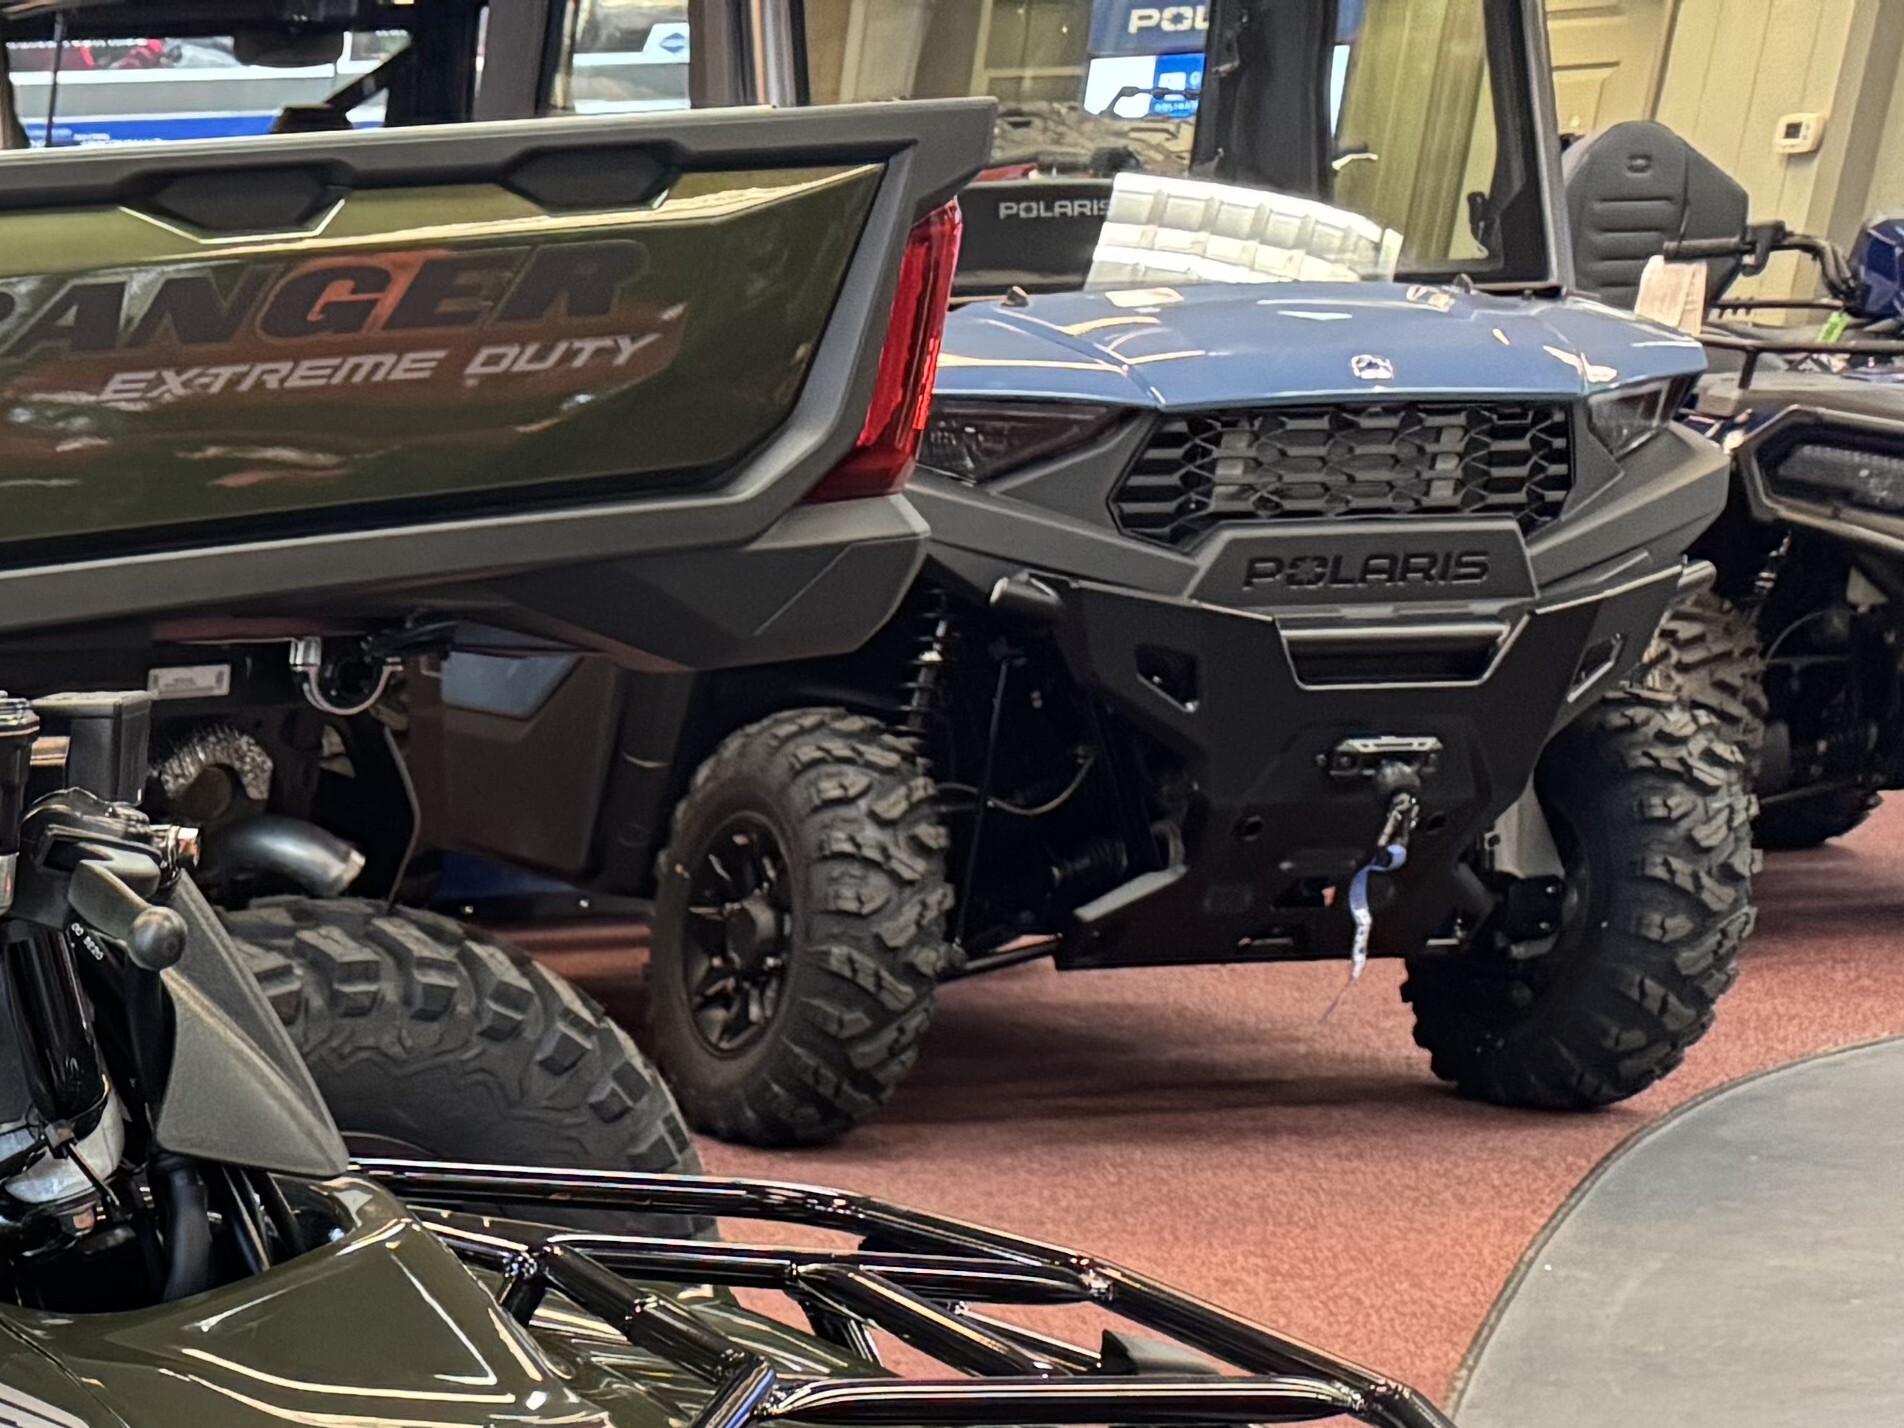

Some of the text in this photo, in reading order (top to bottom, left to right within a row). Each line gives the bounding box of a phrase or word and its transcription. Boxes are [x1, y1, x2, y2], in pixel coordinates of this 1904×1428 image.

[98, 333, 662, 402] EXTREME DUTY
[1243, 550, 1490, 590] POLARIS
